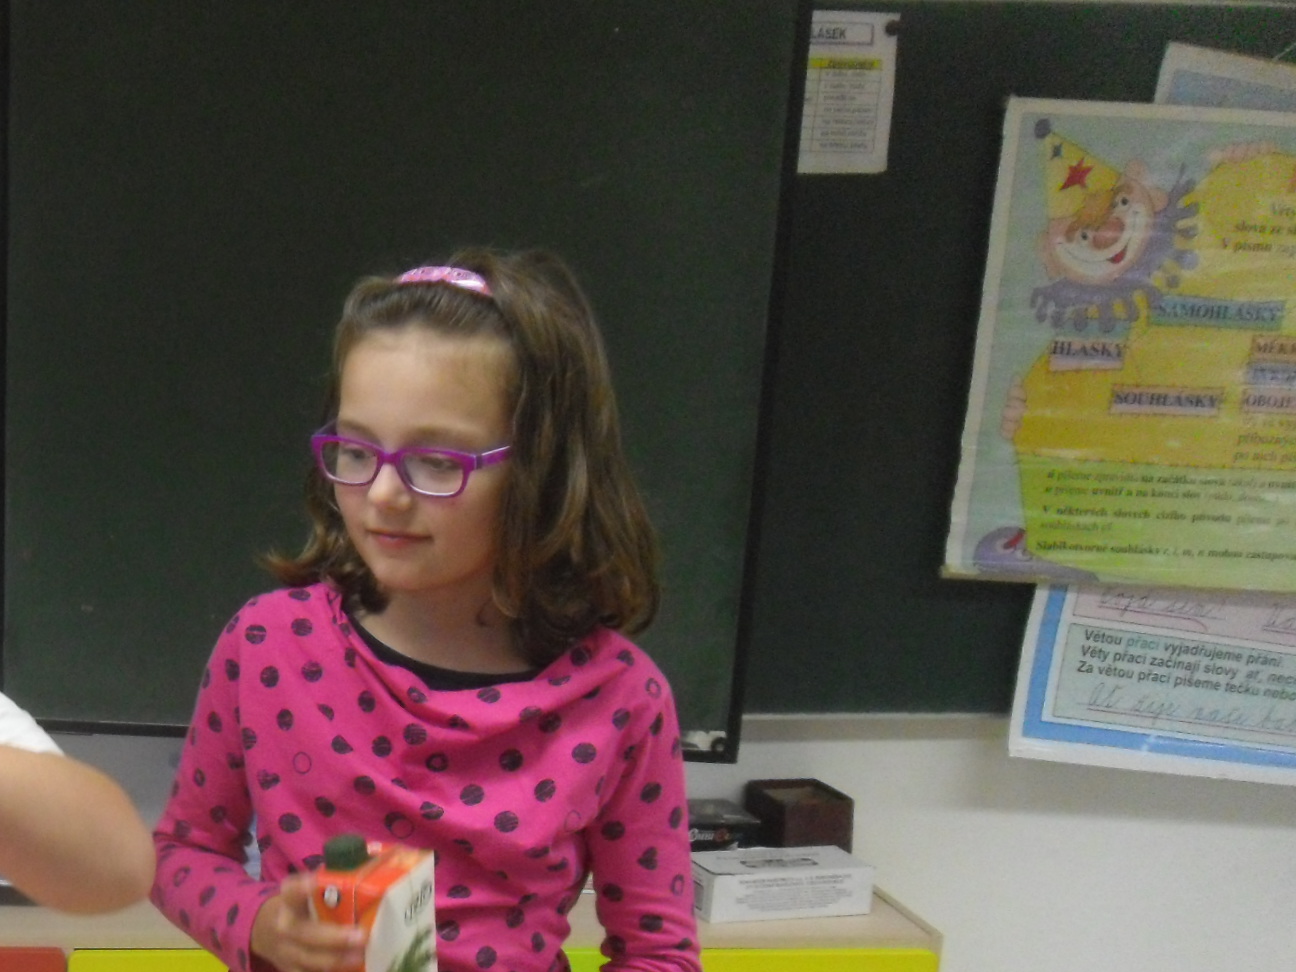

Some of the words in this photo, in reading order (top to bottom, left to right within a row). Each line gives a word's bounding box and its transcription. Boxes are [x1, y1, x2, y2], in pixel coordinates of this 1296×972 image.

[1114, 390, 1218, 408] SOUHLÁSKY
[1084, 628, 1123, 647] Větou
[1164, 640, 1243, 663] vyjadřujeme
[1076, 660, 1094, 675] Za
[1097, 665, 1135, 680] větou
[1080, 644, 1110, 663] Věty
[1203, 661, 1240, 681] slovy
